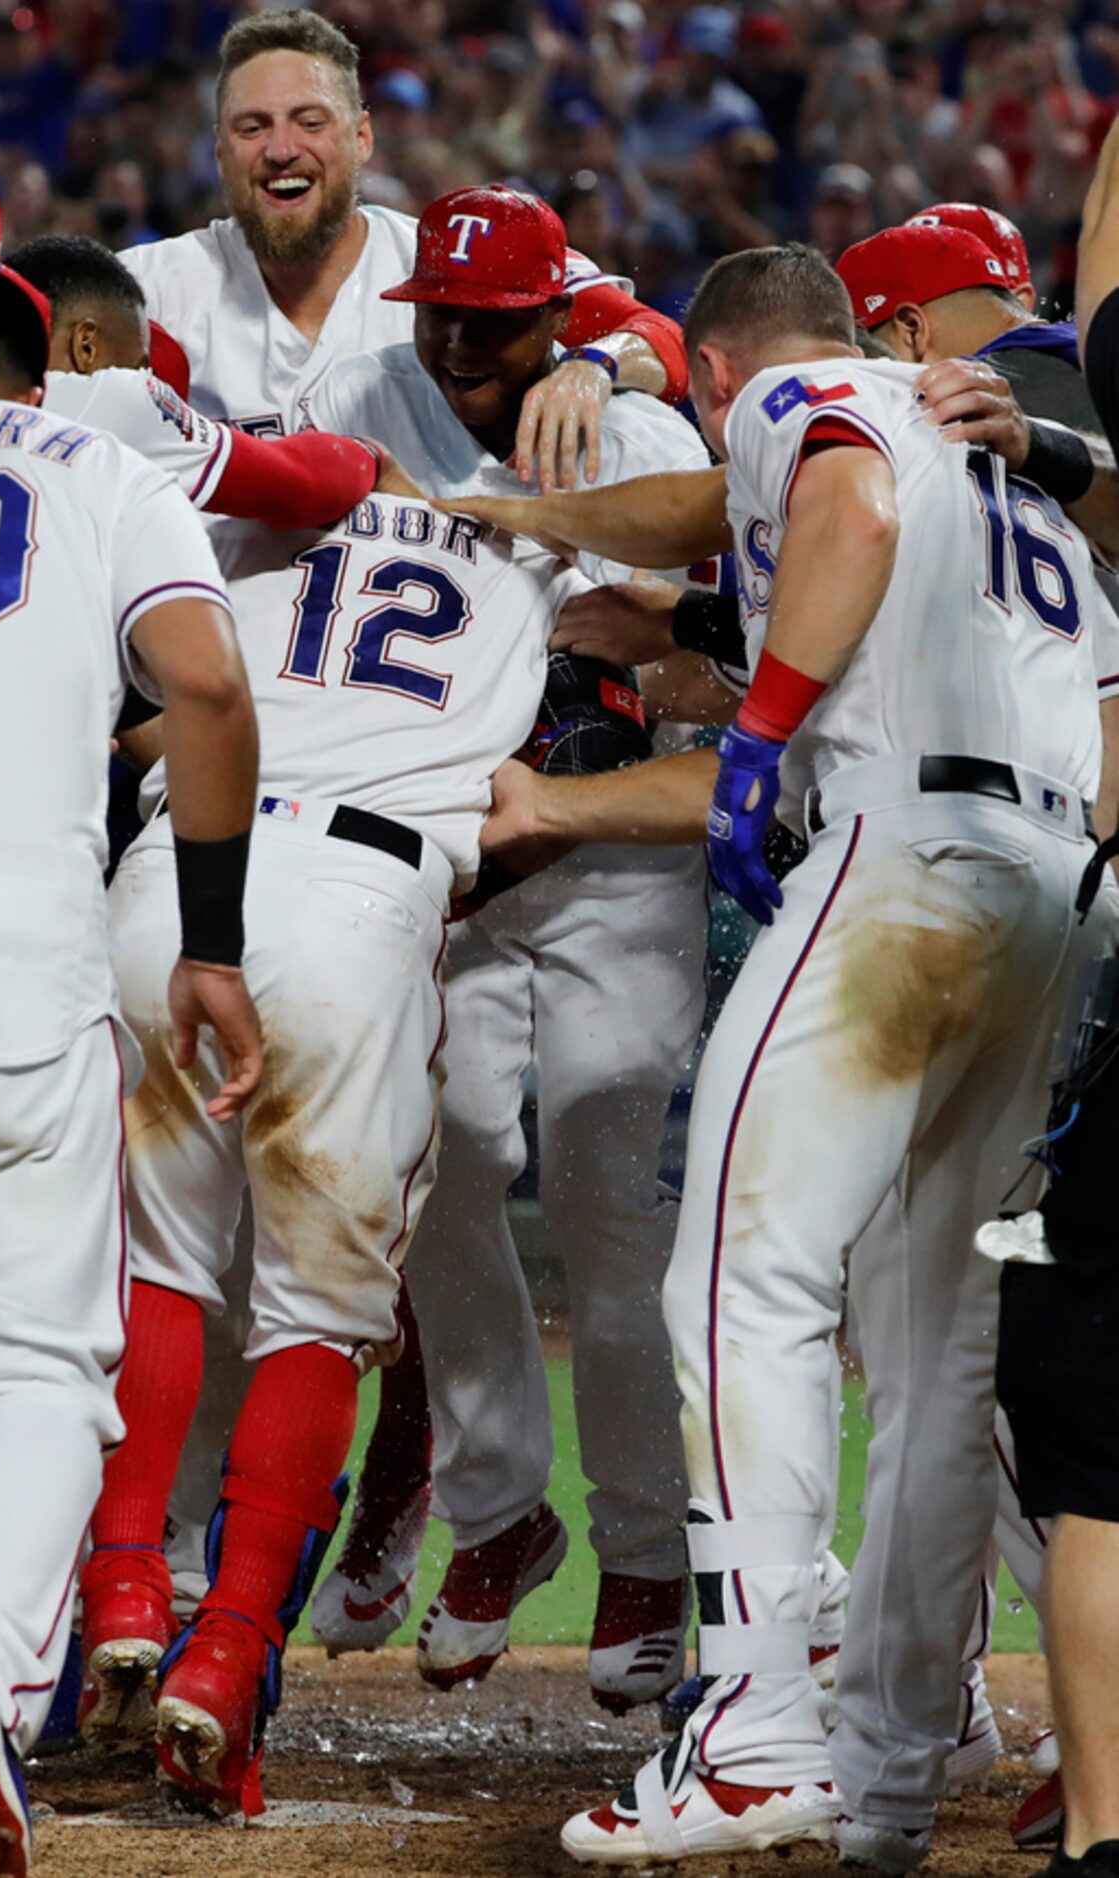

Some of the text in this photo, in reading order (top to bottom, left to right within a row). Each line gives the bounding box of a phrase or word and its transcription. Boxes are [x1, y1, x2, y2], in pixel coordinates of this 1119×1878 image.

[447, 214, 493, 265] T
[344, 499, 477, 565] DOR
[966, 450, 1084, 643] 16
[277, 540, 474, 712] 12
